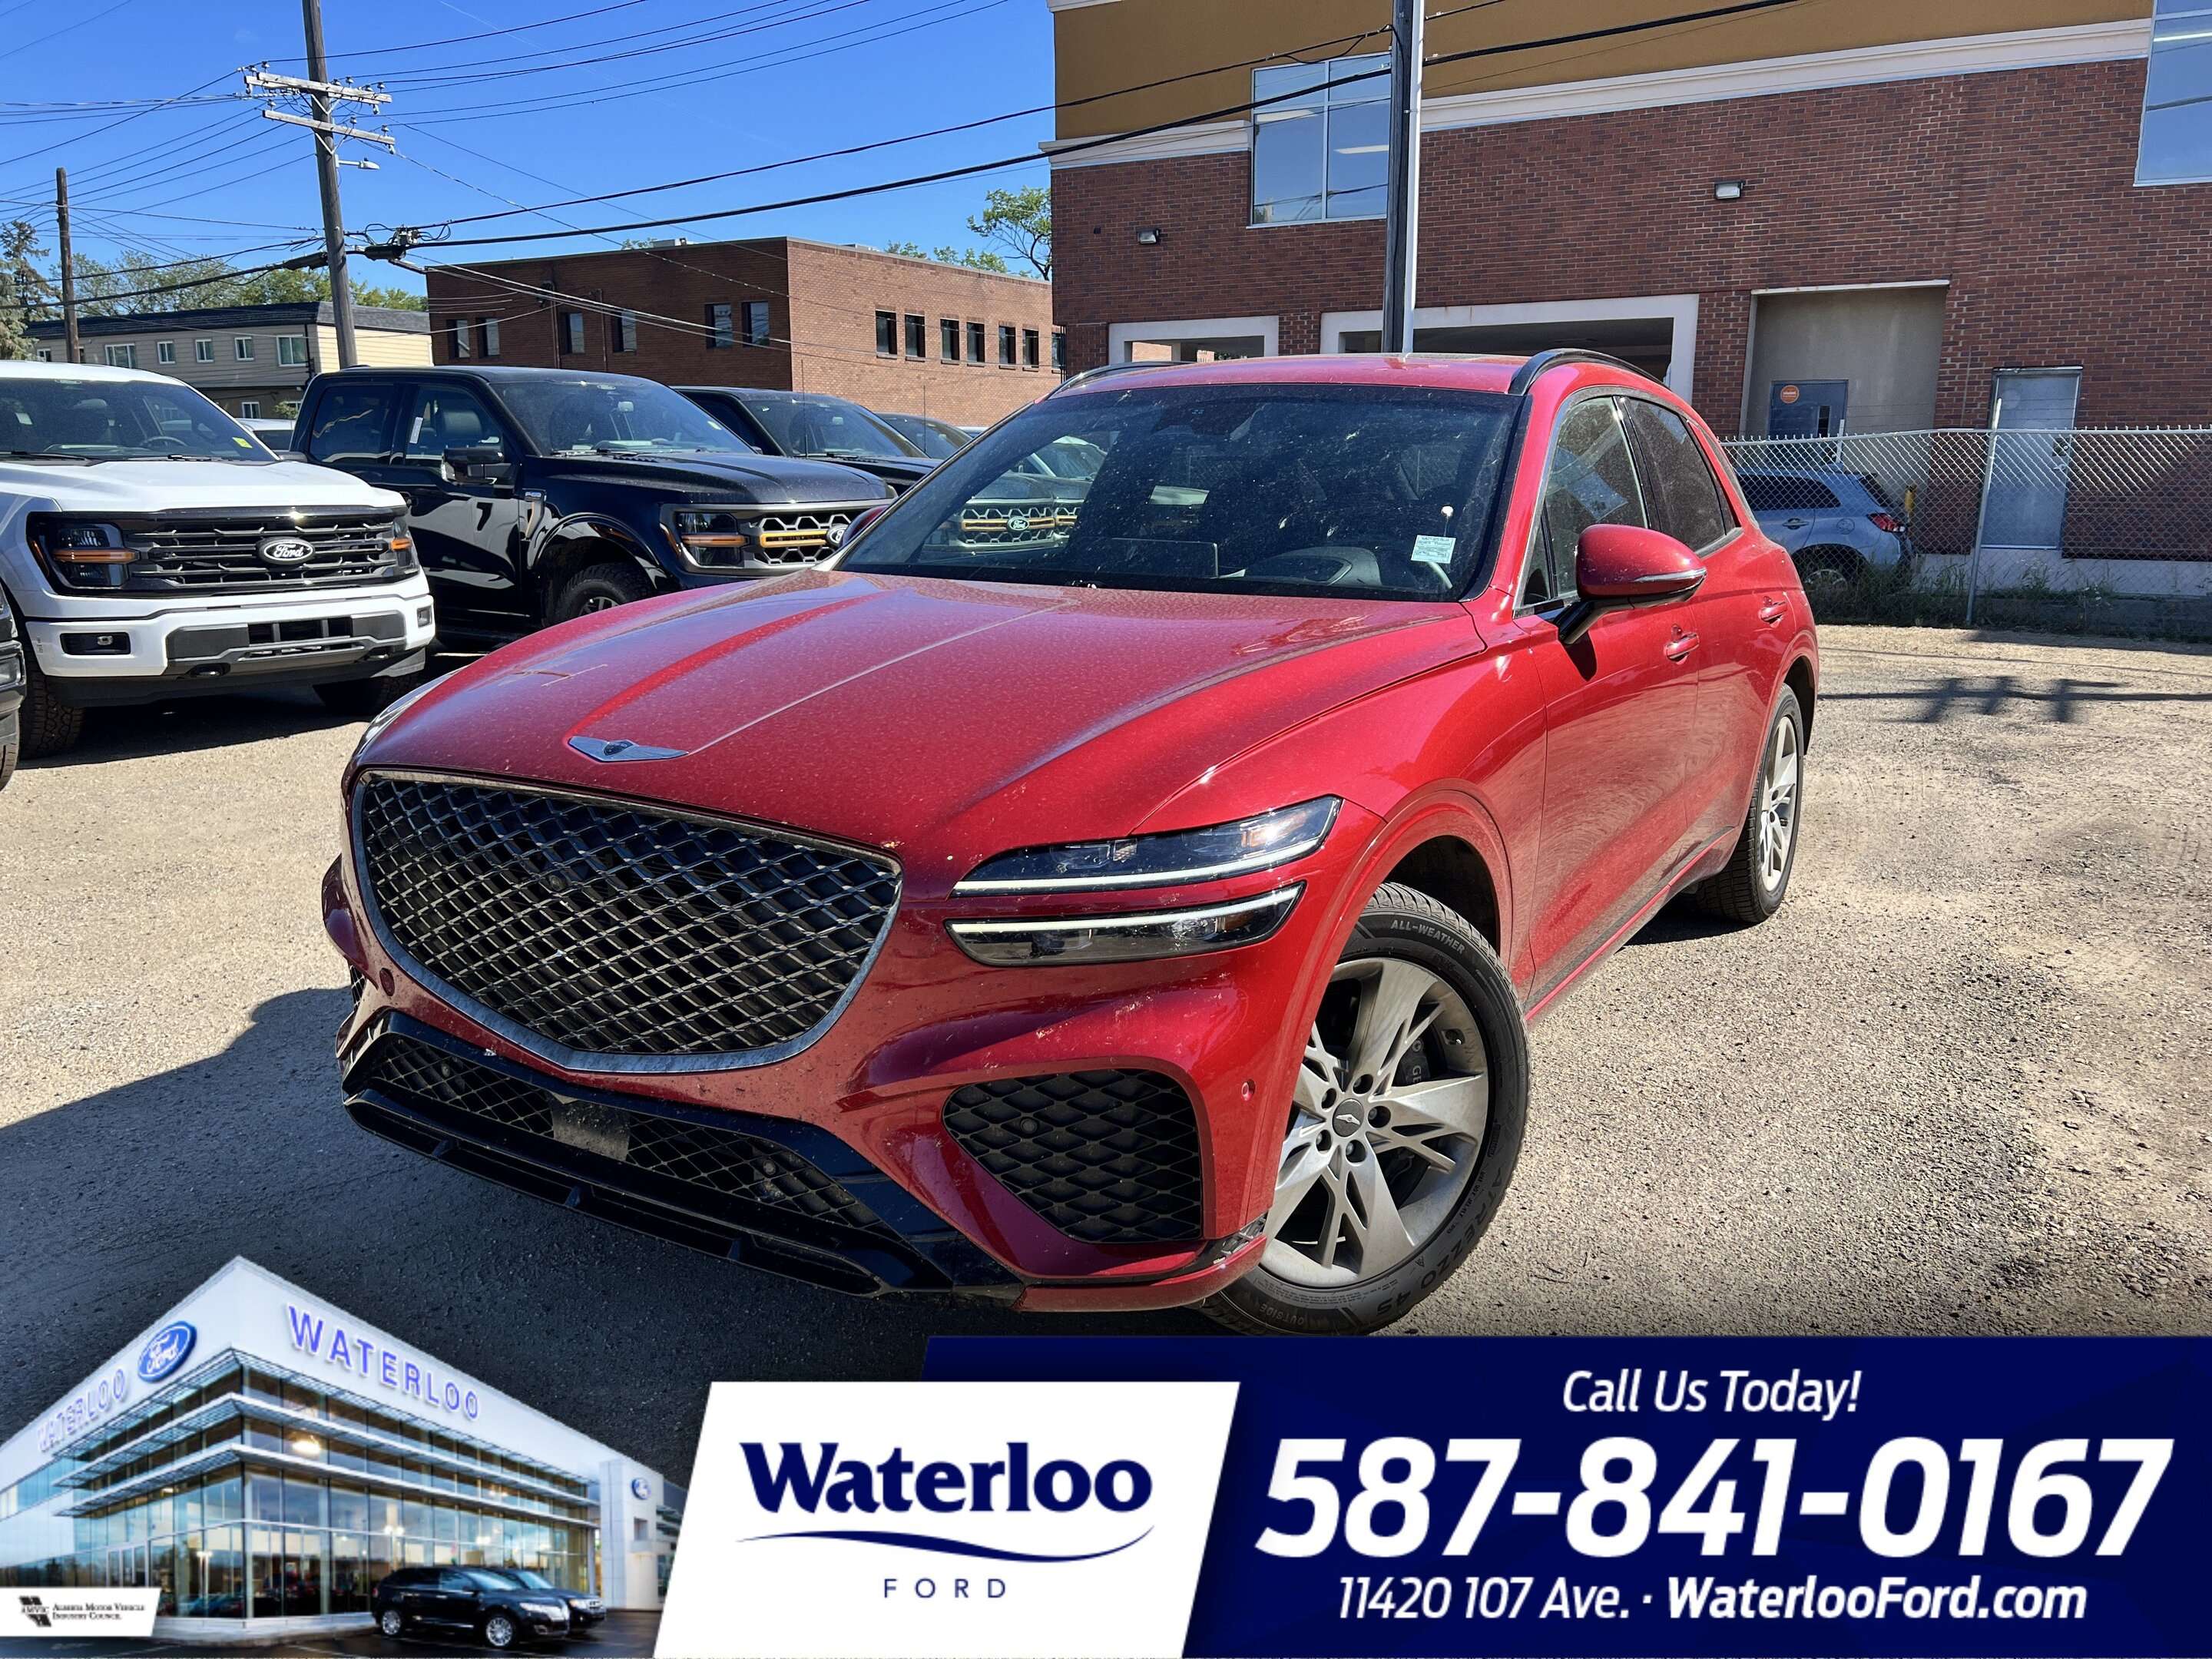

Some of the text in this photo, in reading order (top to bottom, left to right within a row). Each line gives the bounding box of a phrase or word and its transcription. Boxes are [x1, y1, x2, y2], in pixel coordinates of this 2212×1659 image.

[273, 543, 305, 558] Ford
[1390, 919, 1465, 954] ALL-WEATHER
[1260, 1303, 1305, 1326] OUTSIDE
